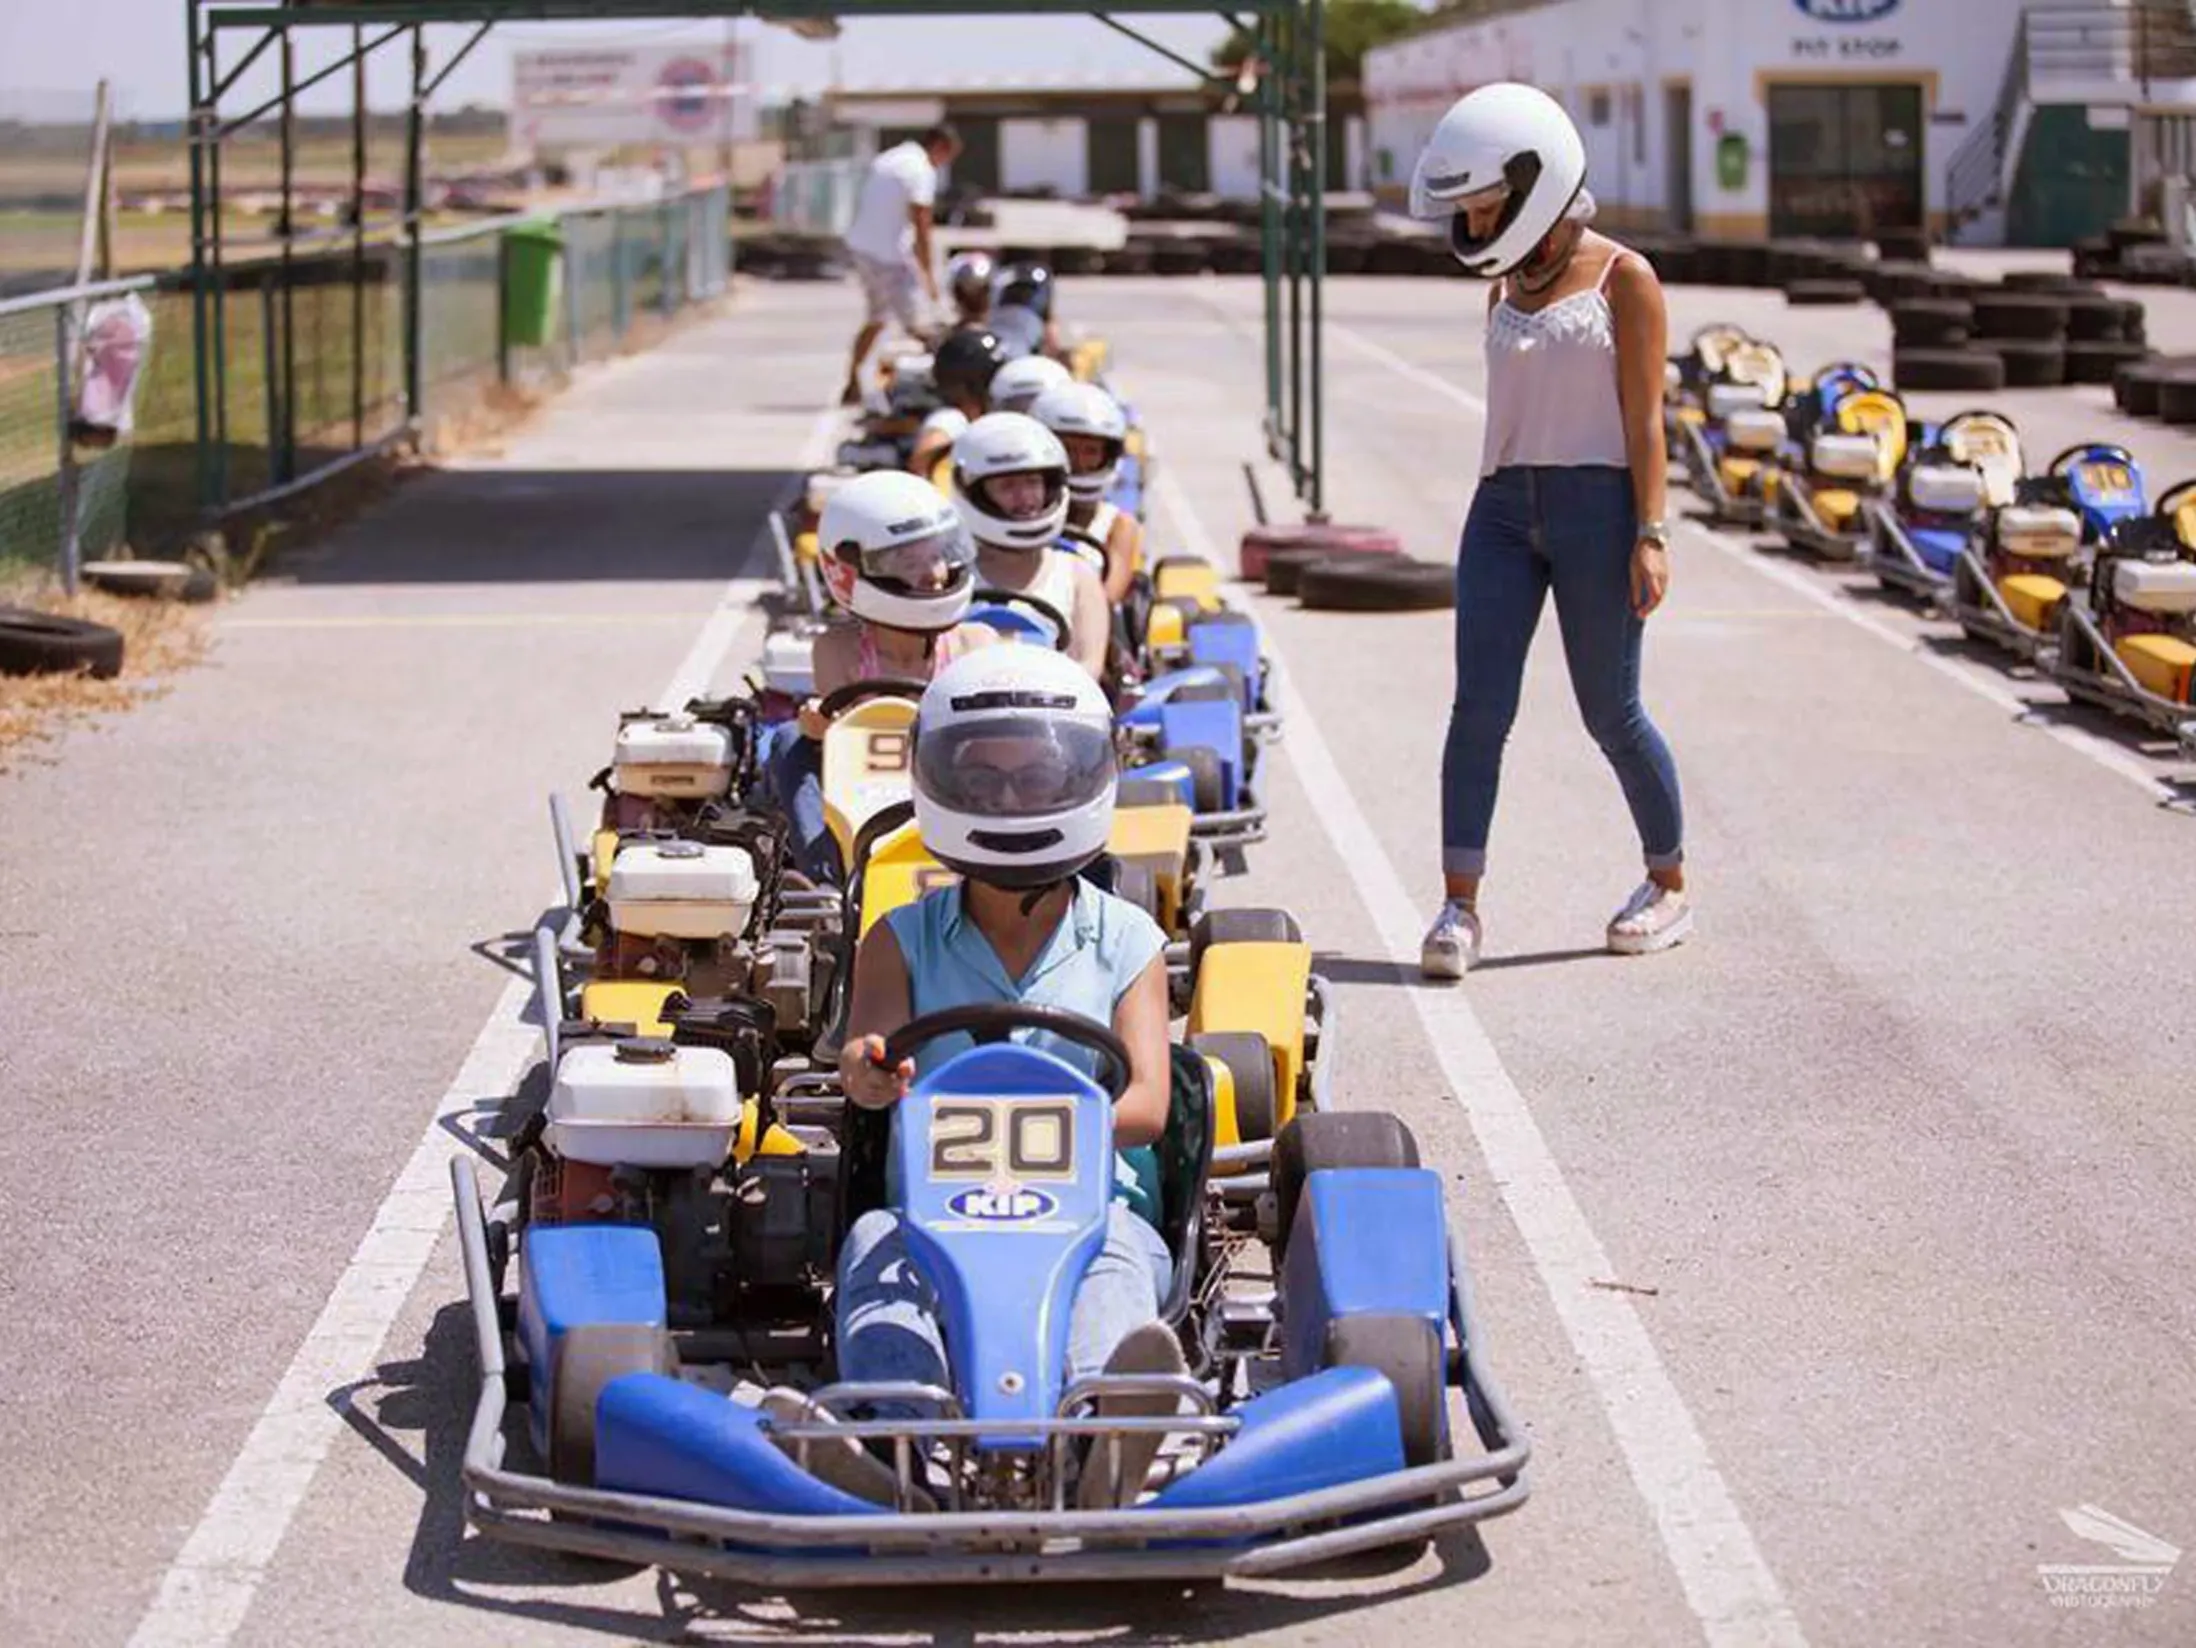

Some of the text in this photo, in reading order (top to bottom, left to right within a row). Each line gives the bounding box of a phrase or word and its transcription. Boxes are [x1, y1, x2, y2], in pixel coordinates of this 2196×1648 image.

[1791, 36, 1903, 59] PIT STOP
[934, 1106, 1072, 1172] 20
[964, 1195, 1043, 1216] KIP
